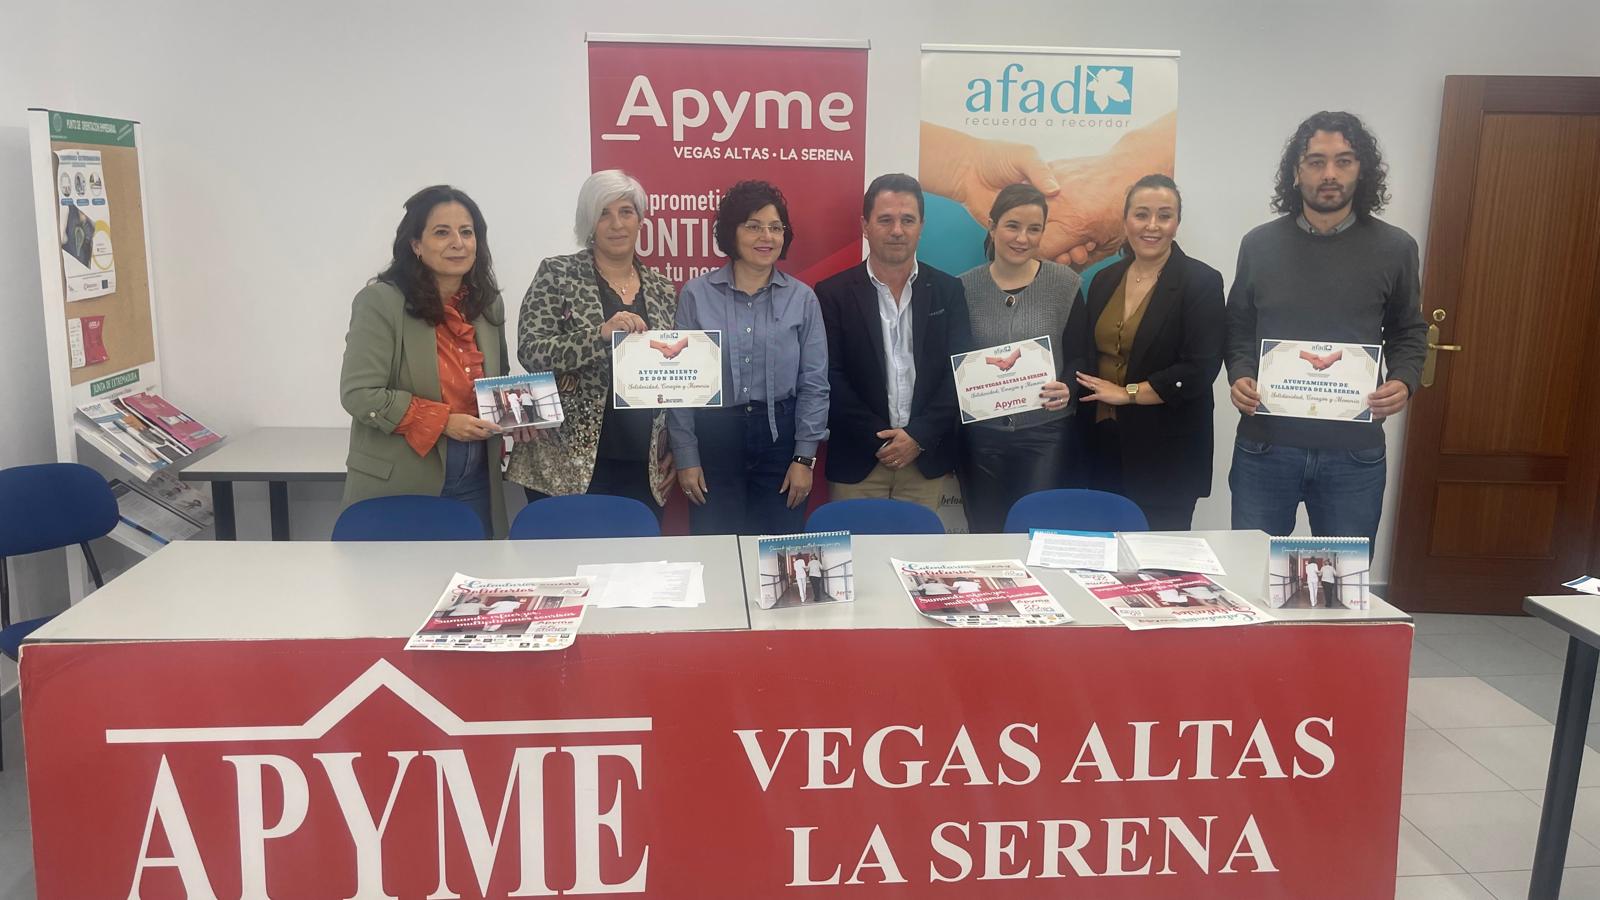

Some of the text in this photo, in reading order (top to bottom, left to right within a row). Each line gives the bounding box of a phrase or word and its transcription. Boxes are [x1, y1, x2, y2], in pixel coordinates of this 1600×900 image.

[965, 63, 1081, 114] afad
[615, 75, 854, 142] Apyme
[965, 116, 1130, 129] recuerda a recordar
[673, 146, 853, 161] VEGAS ALTAS LA SERENA
[643, 188, 726, 216] prometi
[665, 262, 683, 281] tu
[93, 382, 106, 396] JUNTA
[111, 371, 138, 388] EXTREMADURA
[1270, 384, 1313, 392] VILLANUEVA
[1283, 379, 1338, 387] AYUNTAMIENTO
[995, 397, 1027, 409] Apyme
[733, 716, 1337, 792] VEGAS ALTAS
[124, 743, 651, 900] APYME
[785, 814, 1281, 887] LA SERENA
